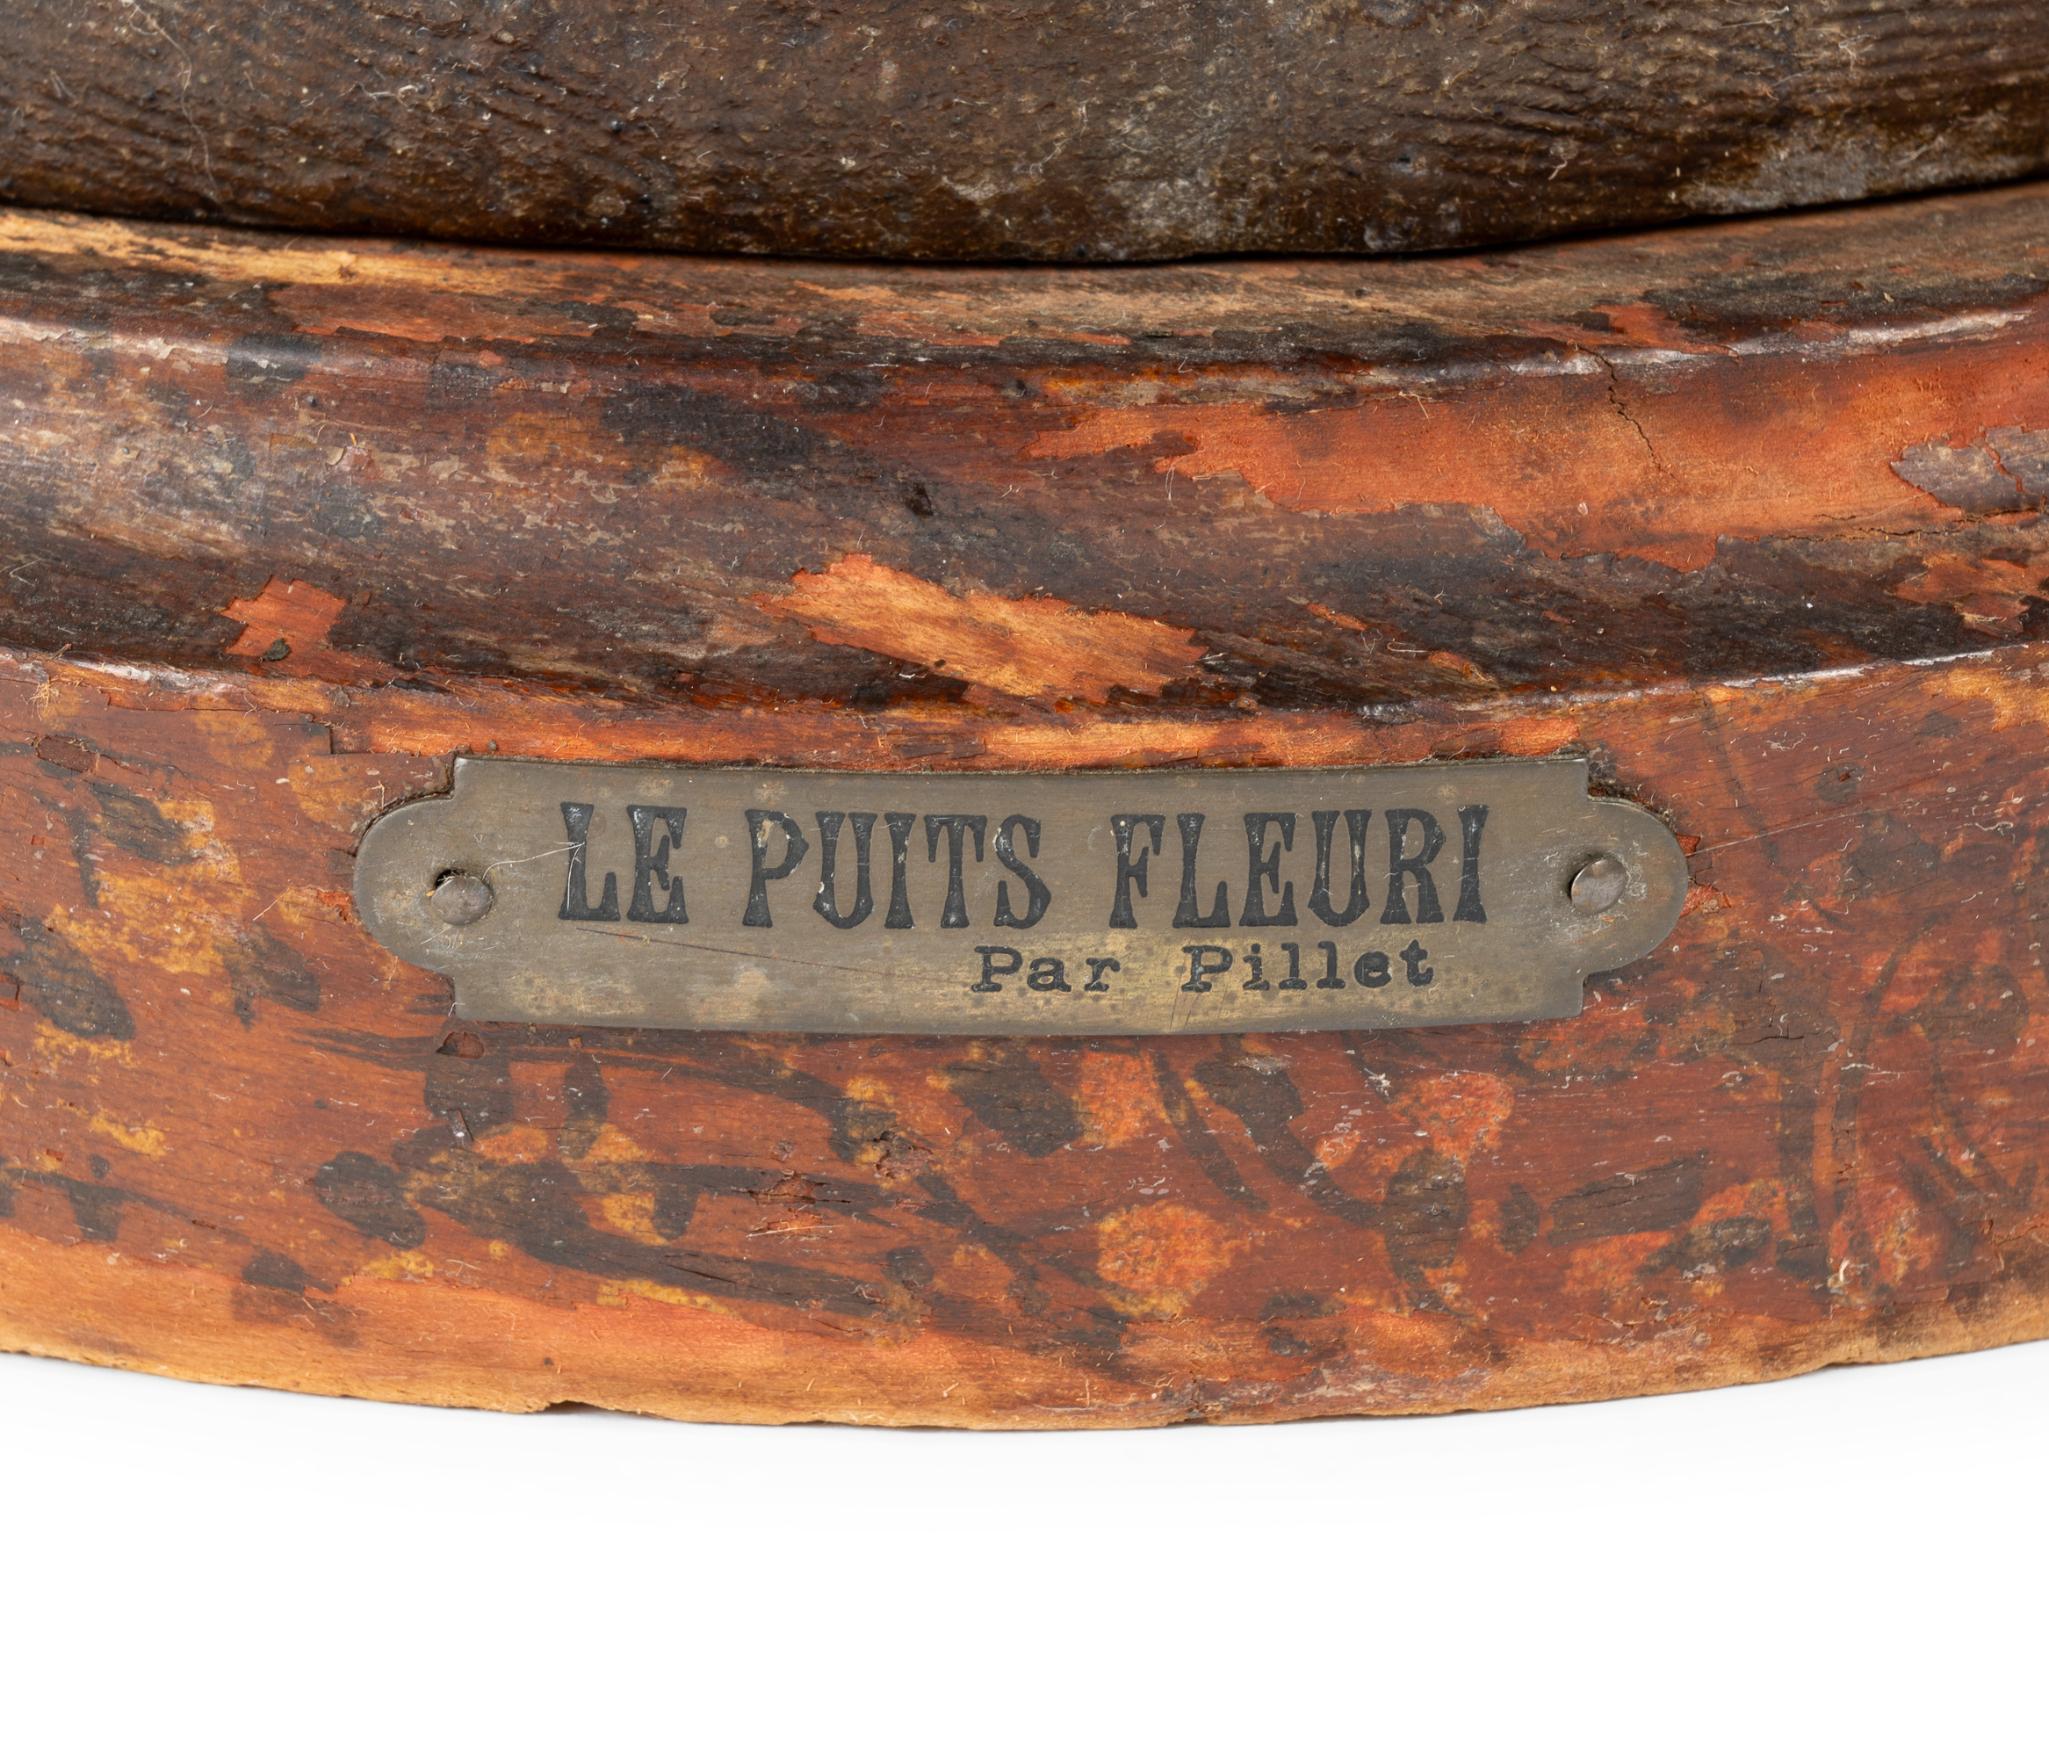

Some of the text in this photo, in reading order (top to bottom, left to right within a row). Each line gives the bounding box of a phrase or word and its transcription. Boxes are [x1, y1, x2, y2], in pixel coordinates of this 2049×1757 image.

[559, 802, 1490, 929] LE PUITS FLEURI
[972, 941, 1435, 993] Par Pillet
